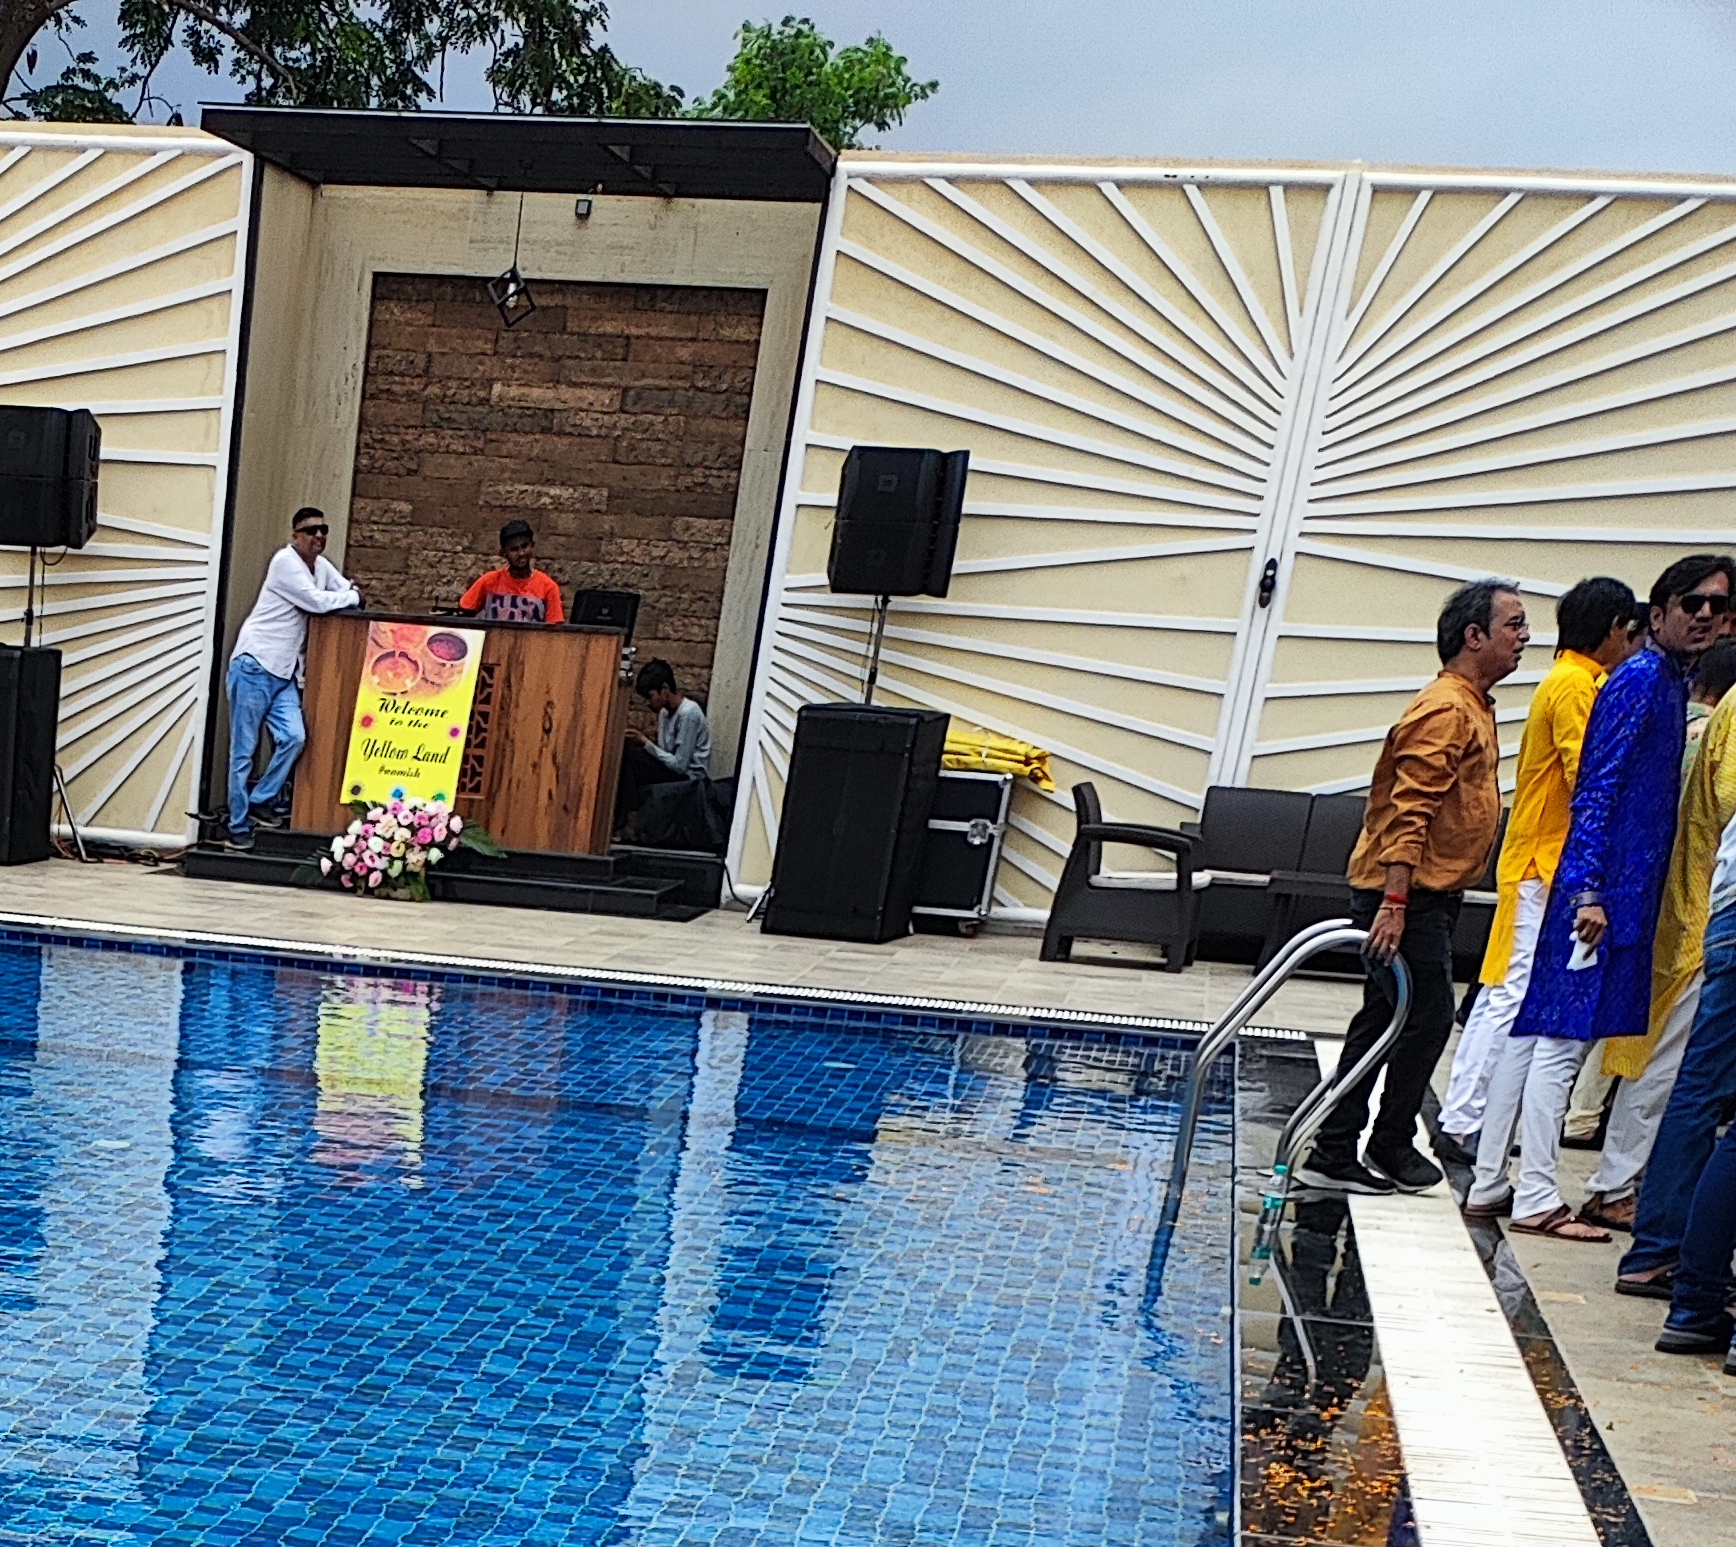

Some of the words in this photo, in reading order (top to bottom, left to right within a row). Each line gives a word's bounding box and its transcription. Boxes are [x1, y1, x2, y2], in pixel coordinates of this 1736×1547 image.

[377, 697, 449, 718] Welcome
[389, 717, 403, 726] to
[407, 719, 430, 729] the
[361, 738, 409, 762] Yellow
[412, 743, 452, 764] Land
